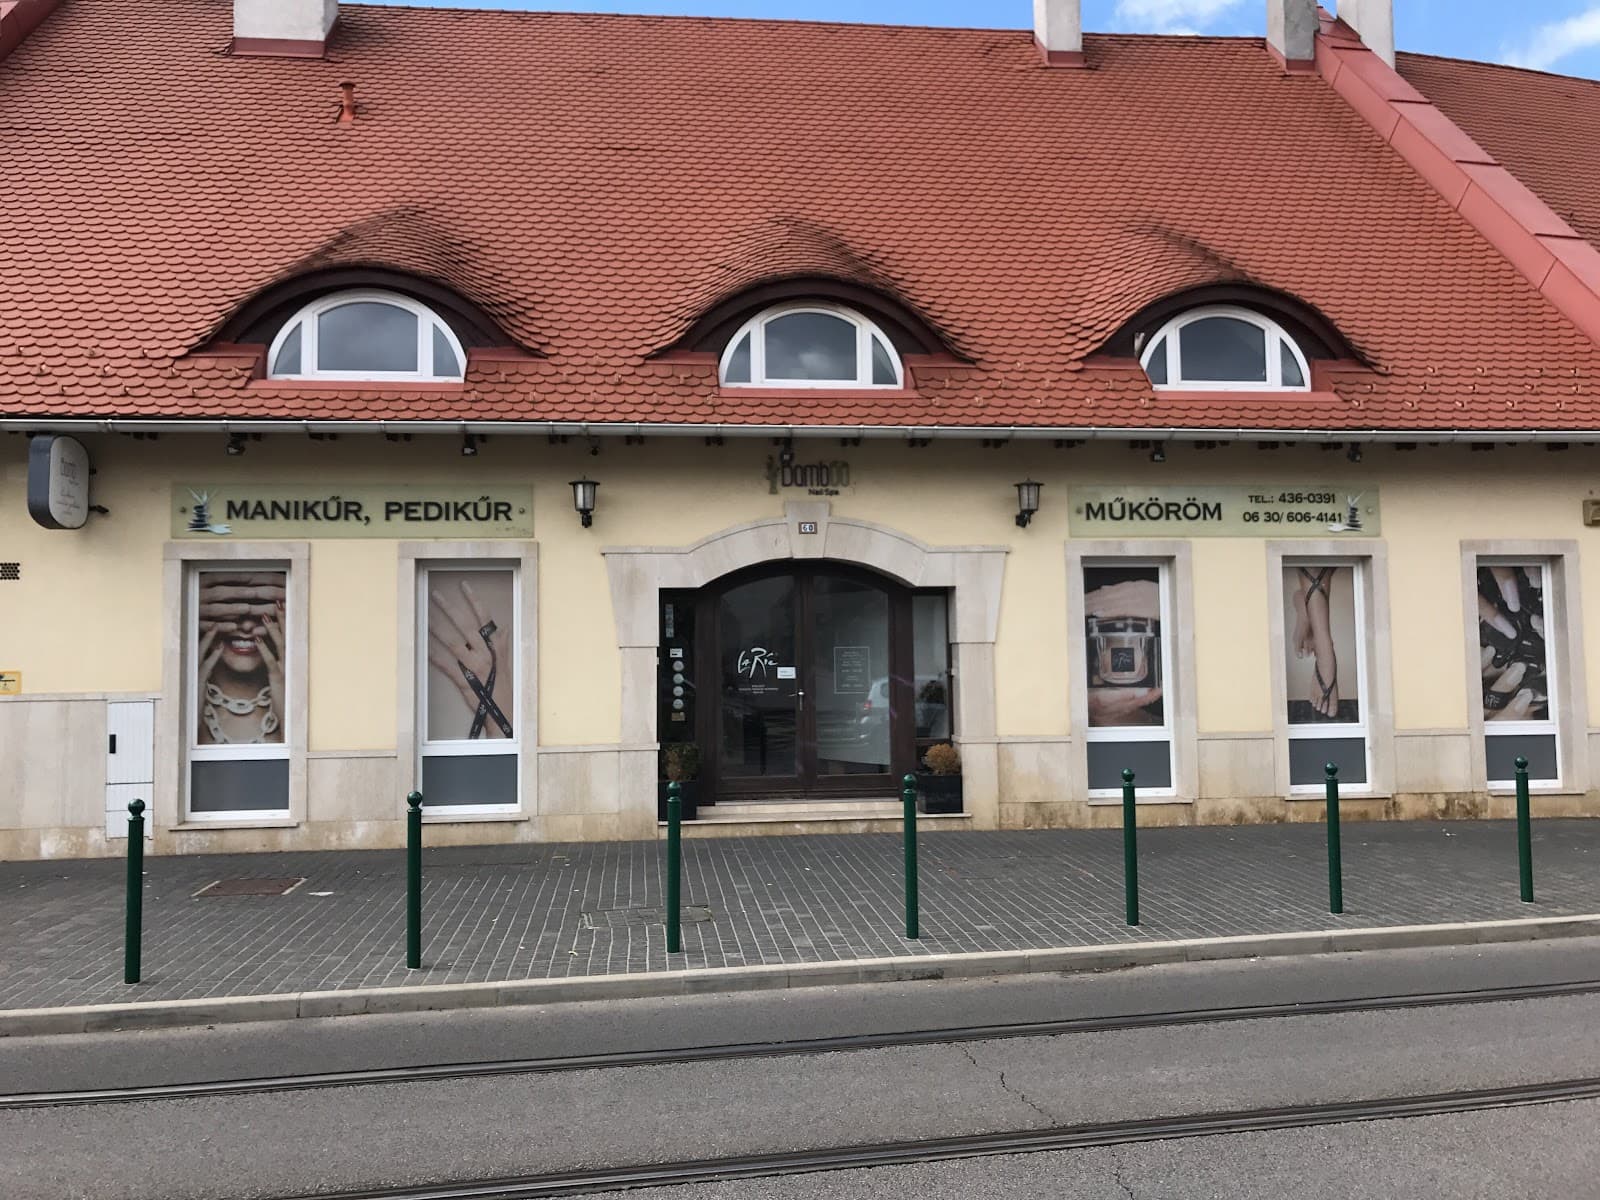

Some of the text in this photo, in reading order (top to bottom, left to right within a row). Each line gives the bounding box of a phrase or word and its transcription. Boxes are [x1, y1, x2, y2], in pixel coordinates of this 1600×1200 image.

[1248, 493, 1335, 504] TEL.: 436-0391
[227, 496, 512, 525] MANIKŰR, PEDIKŰR
[1086, 498, 1222, 521] MŰKÖRÖM
[1243, 511, 1342, 523] 06 30/ 606-4141
